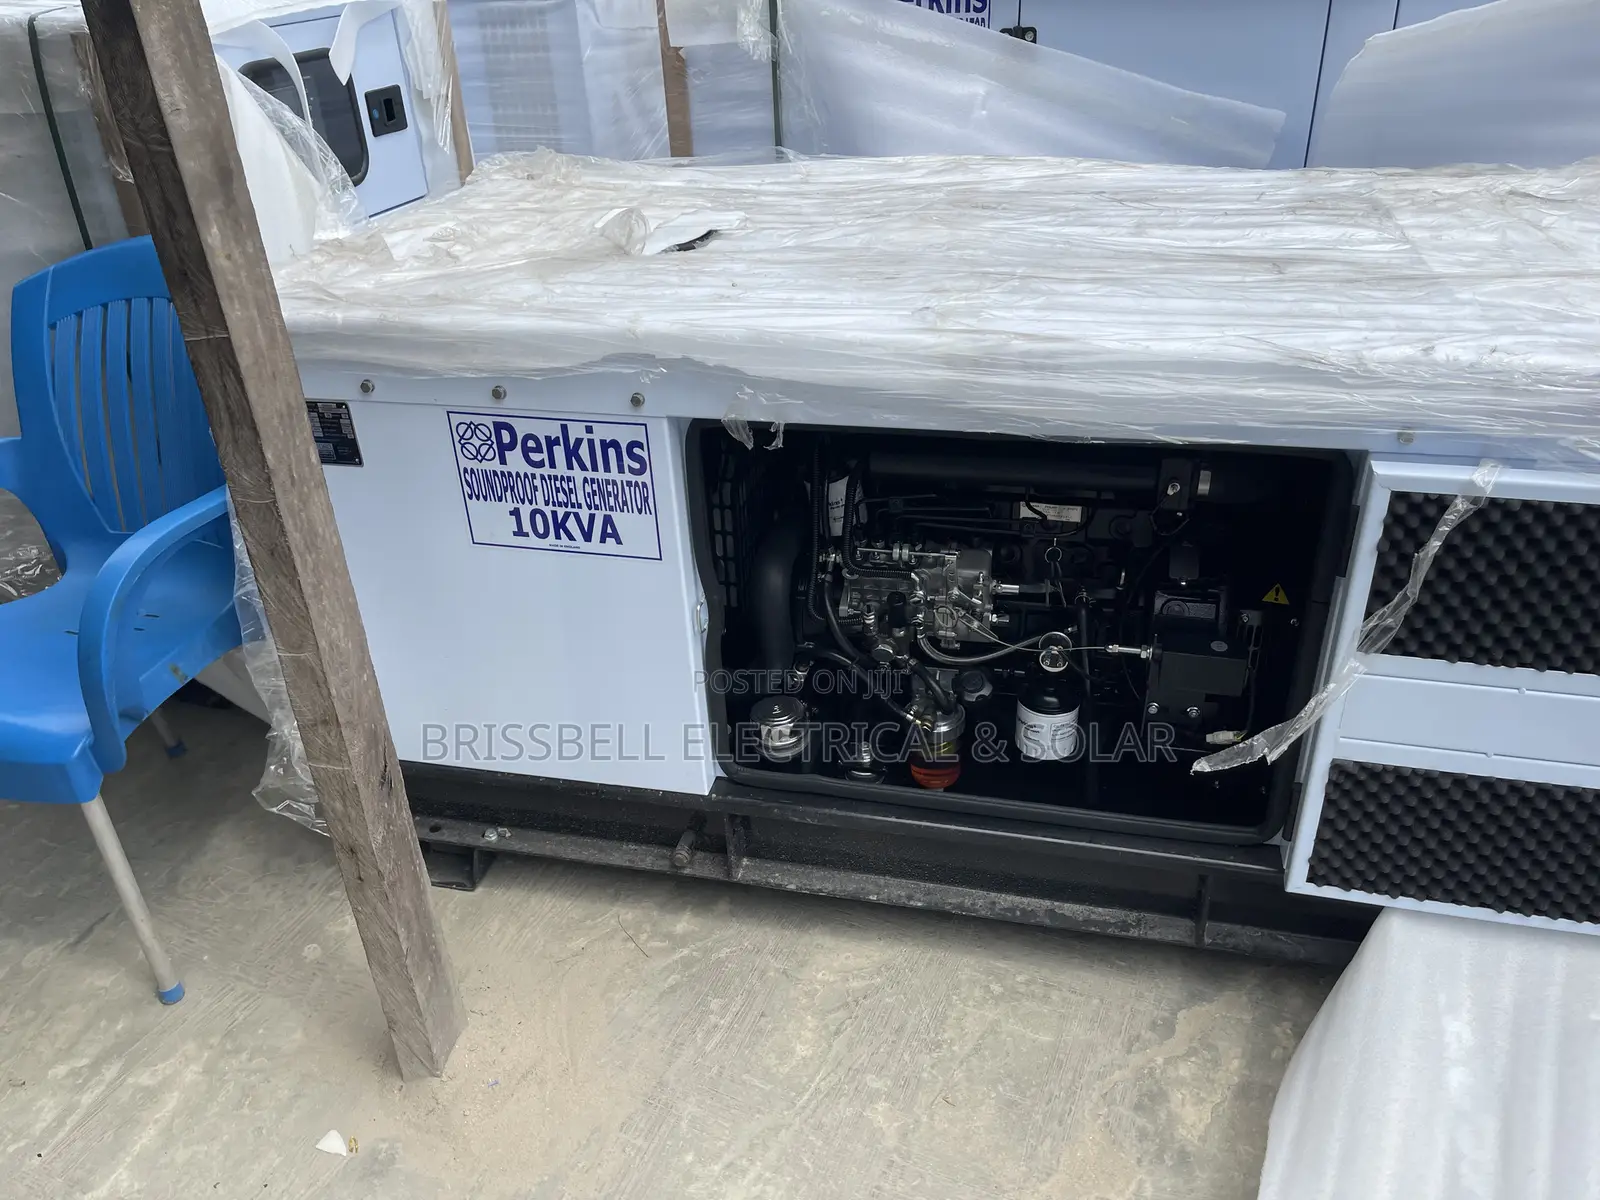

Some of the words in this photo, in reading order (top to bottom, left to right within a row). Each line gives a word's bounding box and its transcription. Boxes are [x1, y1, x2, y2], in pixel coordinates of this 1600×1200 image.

[492, 421, 648, 476] Perkins
[463, 467, 539, 505] SOUNDPROOF
[540, 474, 582, 510] DIESEL
[582, 476, 652, 515] GENERATOR
[509, 507, 623, 545] 10KVA
